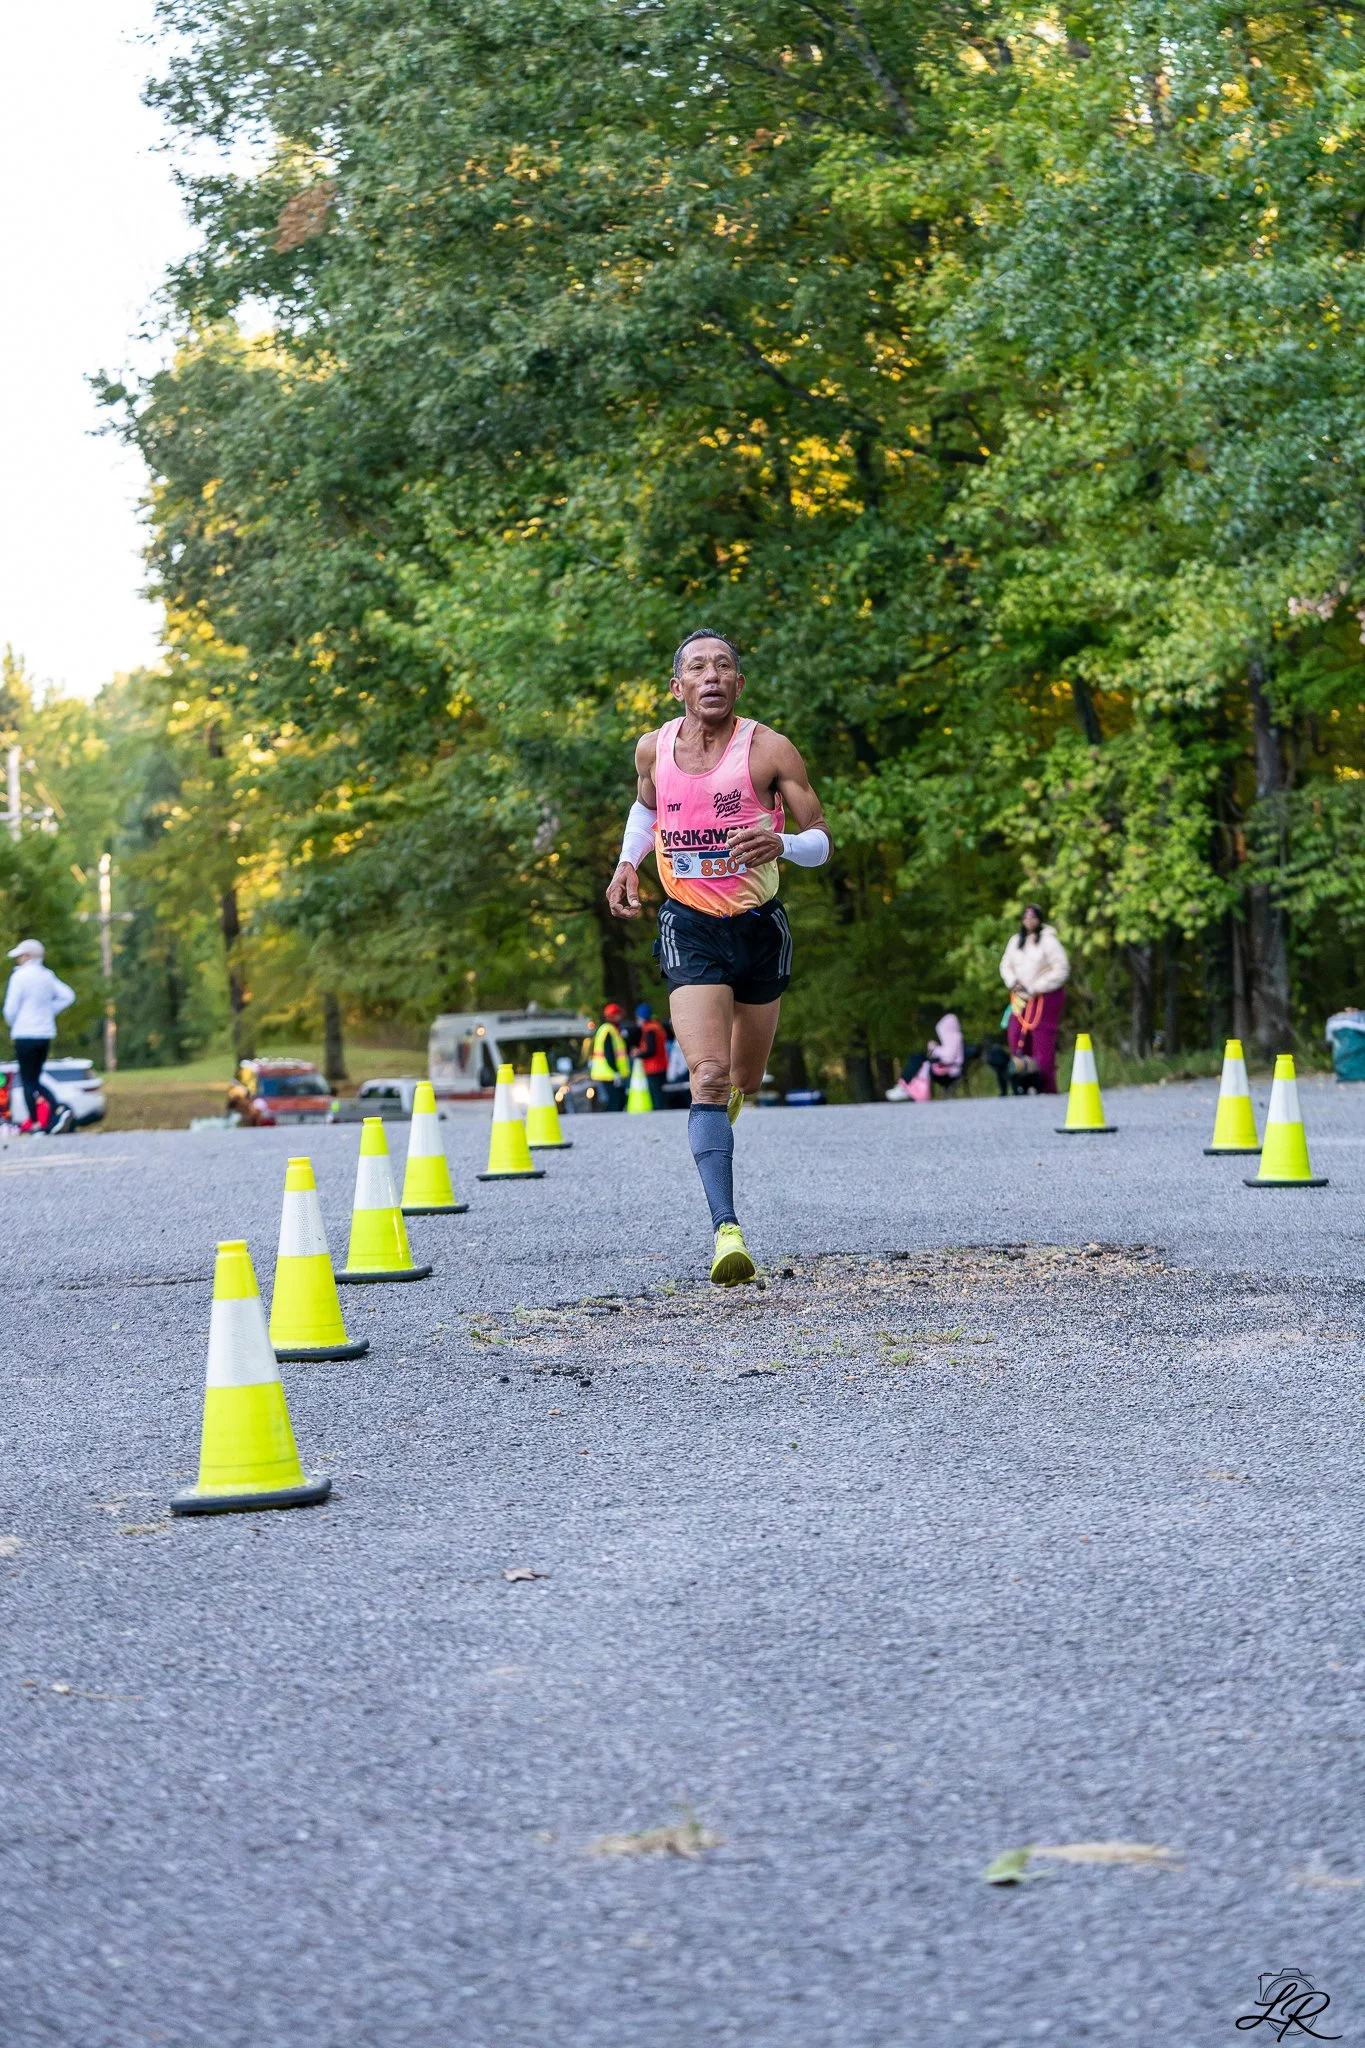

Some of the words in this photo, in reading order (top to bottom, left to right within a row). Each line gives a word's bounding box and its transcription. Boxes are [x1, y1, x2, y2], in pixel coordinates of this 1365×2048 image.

[713, 788, 741, 808] Party
[716, 802, 741, 818] Pace
[661, 826, 748, 847] Breakaw
[701, 857, 739, 876] 830
